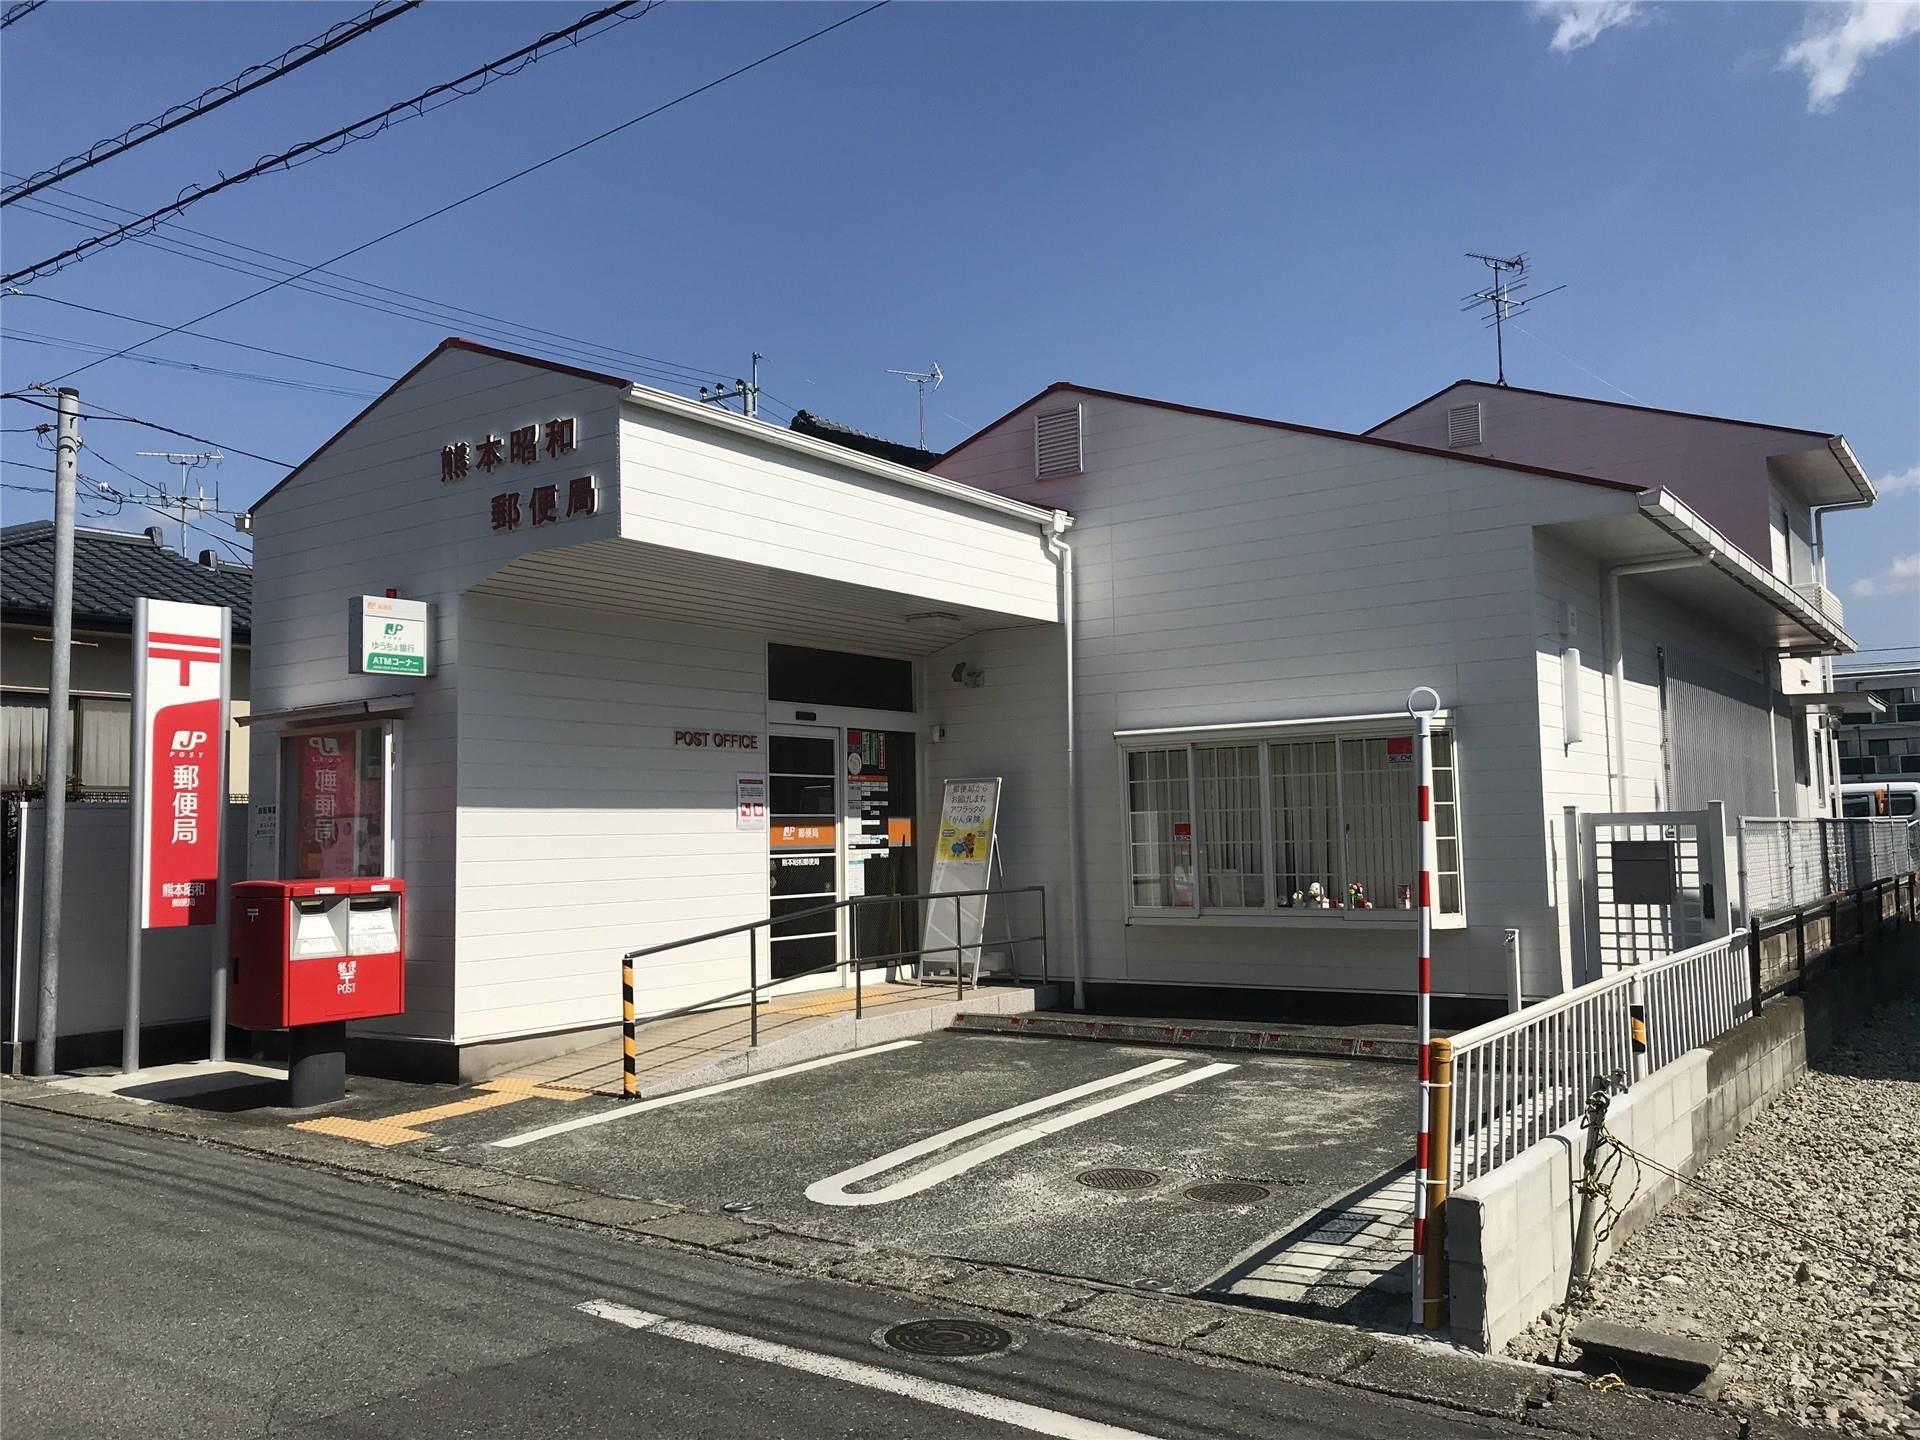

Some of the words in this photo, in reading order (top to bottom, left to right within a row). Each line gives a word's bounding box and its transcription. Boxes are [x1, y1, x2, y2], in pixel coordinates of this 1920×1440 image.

[441, 417, 577, 483] 熊本昭和
[490, 475, 600, 531] 郵便局
[371, 640, 415, 653] ゆうちょ銀行
[372, 656, 419, 667] ATMコーナー
[171, 730, 208, 751] JP
[675, 731, 710, 747] POST
[713, 732, 758, 749] OFFICE
[169, 751, 204, 759] POST
[952, 783, 988, 794] 郵便局から
[171, 764, 200, 845] 郵便局
[950, 805, 986, 814] アフラックの
[162, 882, 206, 898] 熊本昭和
[171, 898, 196, 908] 郵便局
[337, 960, 357, 975] 郵便
[337, 982, 357, 995] POST
